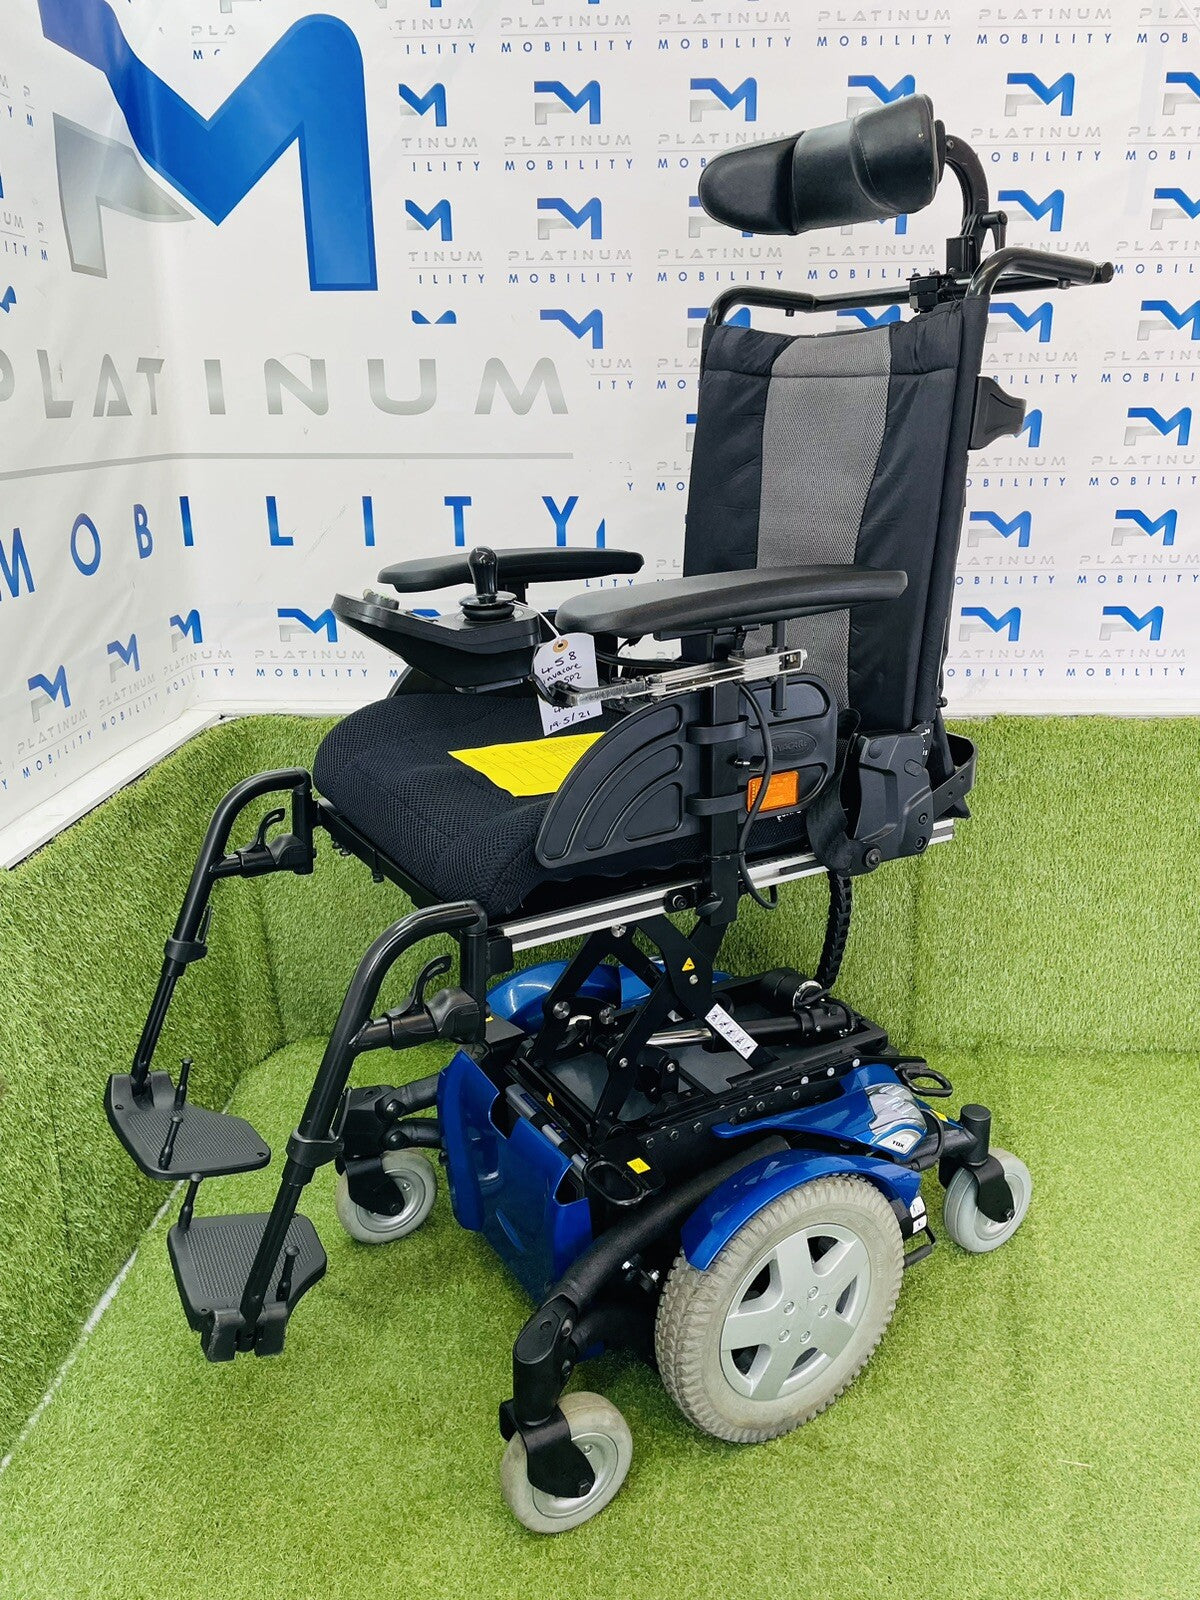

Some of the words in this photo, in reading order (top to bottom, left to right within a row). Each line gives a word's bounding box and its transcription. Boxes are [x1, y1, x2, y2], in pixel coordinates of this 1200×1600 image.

[658, 11, 791, 26] PLATINUM
[816, 8, 951, 22] PLATINUM
[975, 7, 1112, 24] PLATINUM
[1139, 6, 1200, 19] PLAT
[394, 17, 474, 31] TINUM
[500, 14, 631, 29] PLATINUM
[657, 36, 792, 50] MOBILITY
[816, 34, 951, 47] MOBILITY
[976, 33, 1112, 45] MOBILITY
[406, 42, 476, 55] ILITY
[500, 39, 633, 53] MOBILITY
[970, 126, 1102, 139] PLATINUM
[1127, 125, 1200, 138] PLAT
[401, 136, 478, 149] TINUM
[504, 134, 632, 147] PLATINUM
[990, 150, 1102, 163] OBILITY
[1125, 149, 1192, 161] MOBI
[412, 160, 480, 172] ILITY
[504, 158, 633, 171] MOBILITY
[407, 250, 483, 262] TINUM
[507, 249, 632, 262] PLATINUM
[657, 246, 783, 260] PLATINUM
[808, 244, 935, 258] PLATINUM
[1113, 263, 1194, 274] MOBIL
[418, 273, 485, 285] ILITY
[508, 272, 634, 284] MOBILITY
[657, 270, 784, 282] MOBILITY
[984, 351, 1078, 364] ATINUM
[1103, 349, 1200, 362] PLATIN
[993, 372, 1079, 384] BILITY
[1100, 372, 1195, 383] MOBILI
[975, 455, 1066, 468] ATINUM
[1088, 454, 1196, 466] PLATINU
[966, 477, 1066, 488] OBILITY
[1088, 475, 1200, 486] MOBILIT
[1079, 553, 1200, 565] PLATINUM
[582, 576, 634, 590] LITY
[955, 575, 1056, 585] OBILITY
[1076, 574, 1200, 584] MOBILITY
[254, 649, 366, 660] PLATINUM
[1068, 647, 1186, 659] PLATINUM
[256, 668, 368, 678] MOBILITY
[947, 668, 1044, 678] OBILITY
[1065, 667, 1186, 677] MOBILITY
